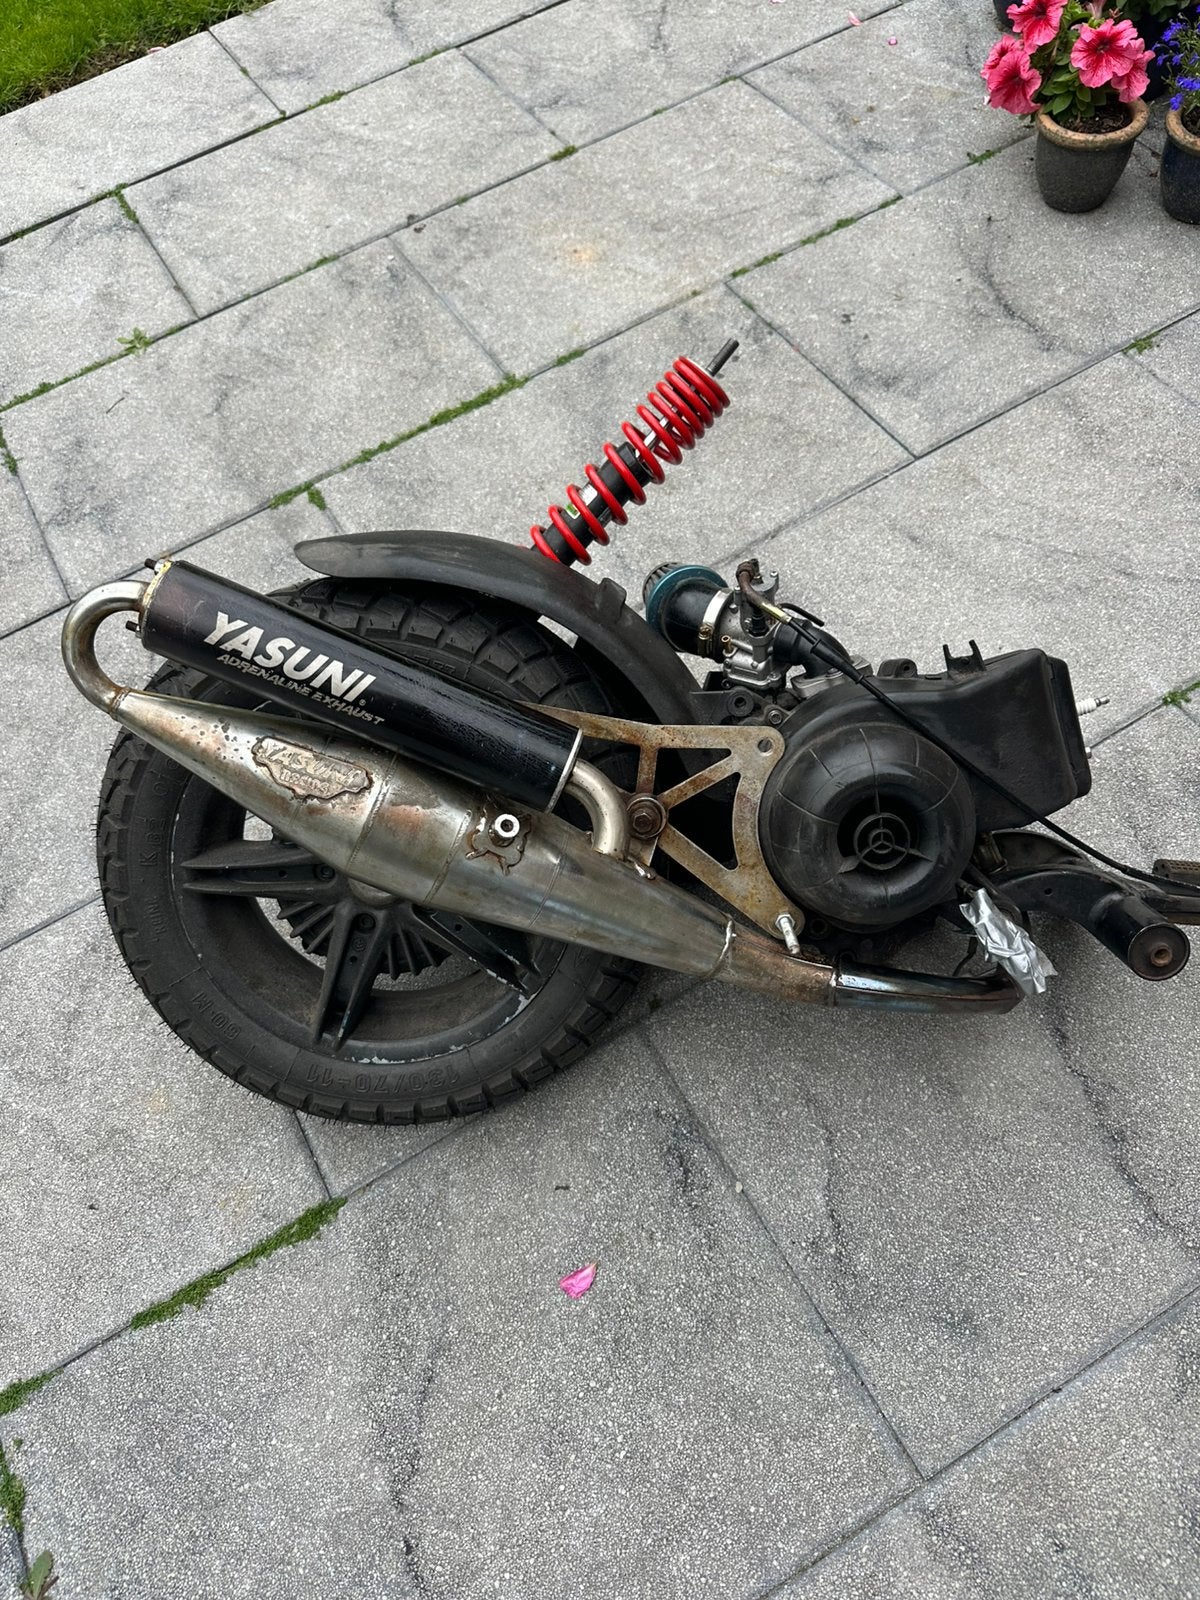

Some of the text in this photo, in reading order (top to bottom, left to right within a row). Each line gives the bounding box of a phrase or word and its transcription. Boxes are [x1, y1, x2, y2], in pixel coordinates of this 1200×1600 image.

[203, 610, 377, 702] YASUNI
[216, 653, 386, 726] ADRENALINE EXHAUST
